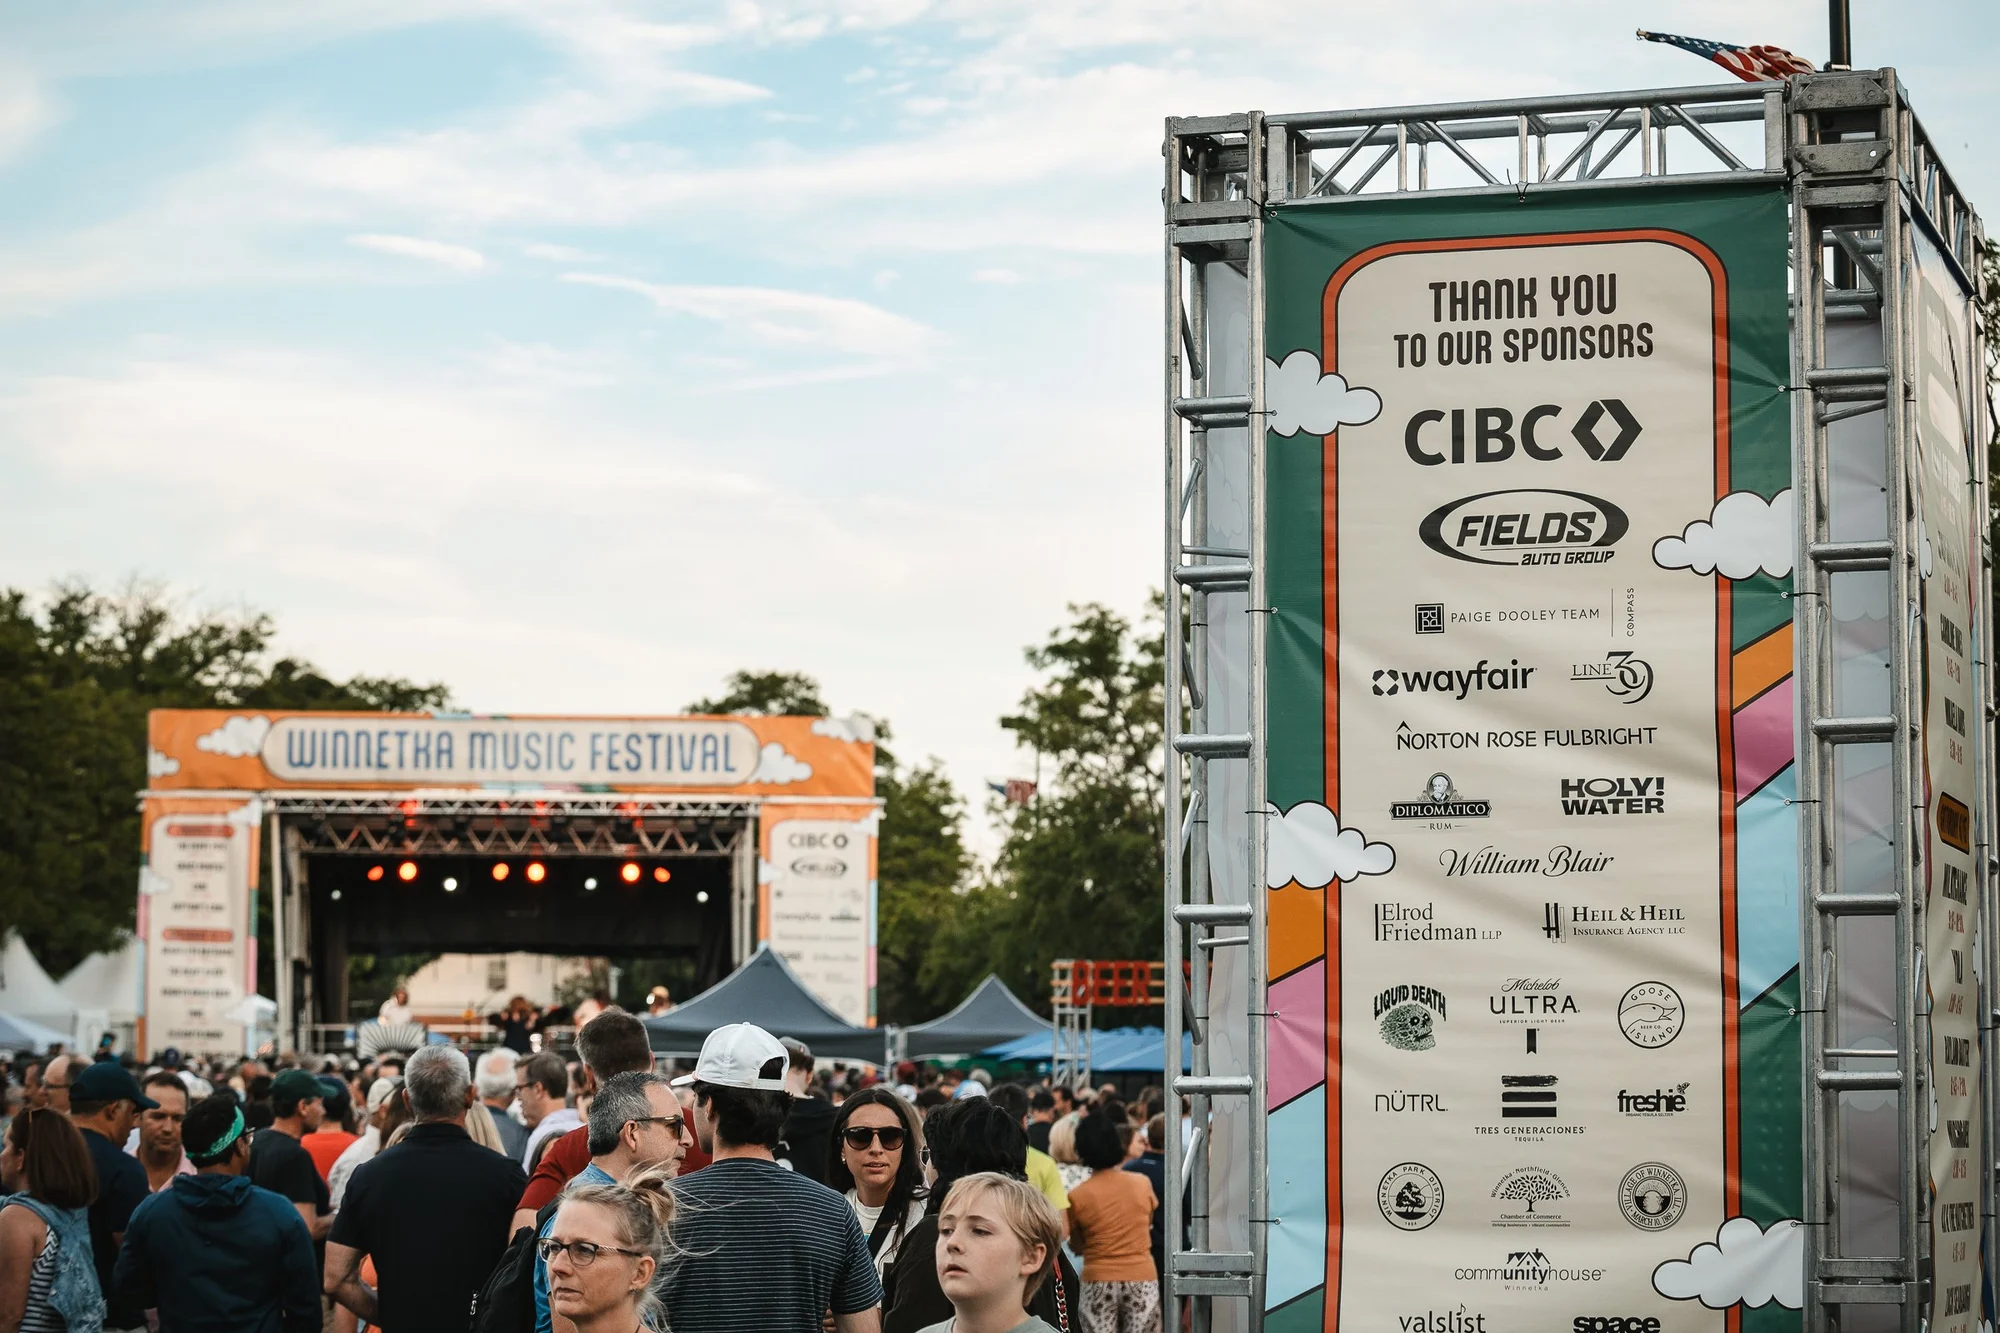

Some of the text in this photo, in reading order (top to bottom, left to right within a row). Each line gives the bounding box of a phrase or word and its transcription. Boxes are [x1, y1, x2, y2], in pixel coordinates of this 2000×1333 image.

[1429, 273, 1617, 322] THANK YOU
[1394, 323, 1654, 368] TO OUR SPONSORS
[1404, 404, 1563, 466] CIBC
[1457, 511, 1597, 547] FIELDS
[1564, 550, 1615, 565] GROUP
[1451, 608, 1600, 623] PAIGE DOOLEY TEAM
[1626, 587, 1635, 637] COMPASS
[1401, 659, 1534, 700] wayfair
[1572, 663, 1612, 677] LINE
[1396, 721, 1658, 750] NORTON ROSE FULBRIGHT
[287, 730, 736, 772] WINNETKA MUSIC FESTIVAL
[1561, 777, 1665, 798] HOLY!
[1395, 803, 1486, 817] DIPLOMÁTICO
[1562, 798, 1665, 815] WATER
[788, 833, 829, 849] CIBC
[1439, 845, 1614, 877] William Blair
[1381, 902, 1434, 921] Elrod
[1620, 907, 1636, 921] &
[1381, 922, 1502, 941] Friedman LLP
[1072, 960, 1150, 1006] BEER
[1501, 978, 1561, 993] Michelob
[1374, 985, 1446, 1021] LIQUID DEATH
[1631, 987, 1672, 1001] GOOSE
[1490, 995, 1578, 1015] ULTRA
[1630, 1026, 1673, 1043] ISLAND
[1617, 1089, 1686, 1112] freshie
[1504, 1126, 1584, 1134] GENERACIONES
[1635, 1169, 1645, 1180] OF
[1381, 1166, 1441, 1219] WINNETKA PARK DISTRICT
[1632, 1211, 1653, 1226] MARCH
[1399, 1303, 1486, 1333] valslist
